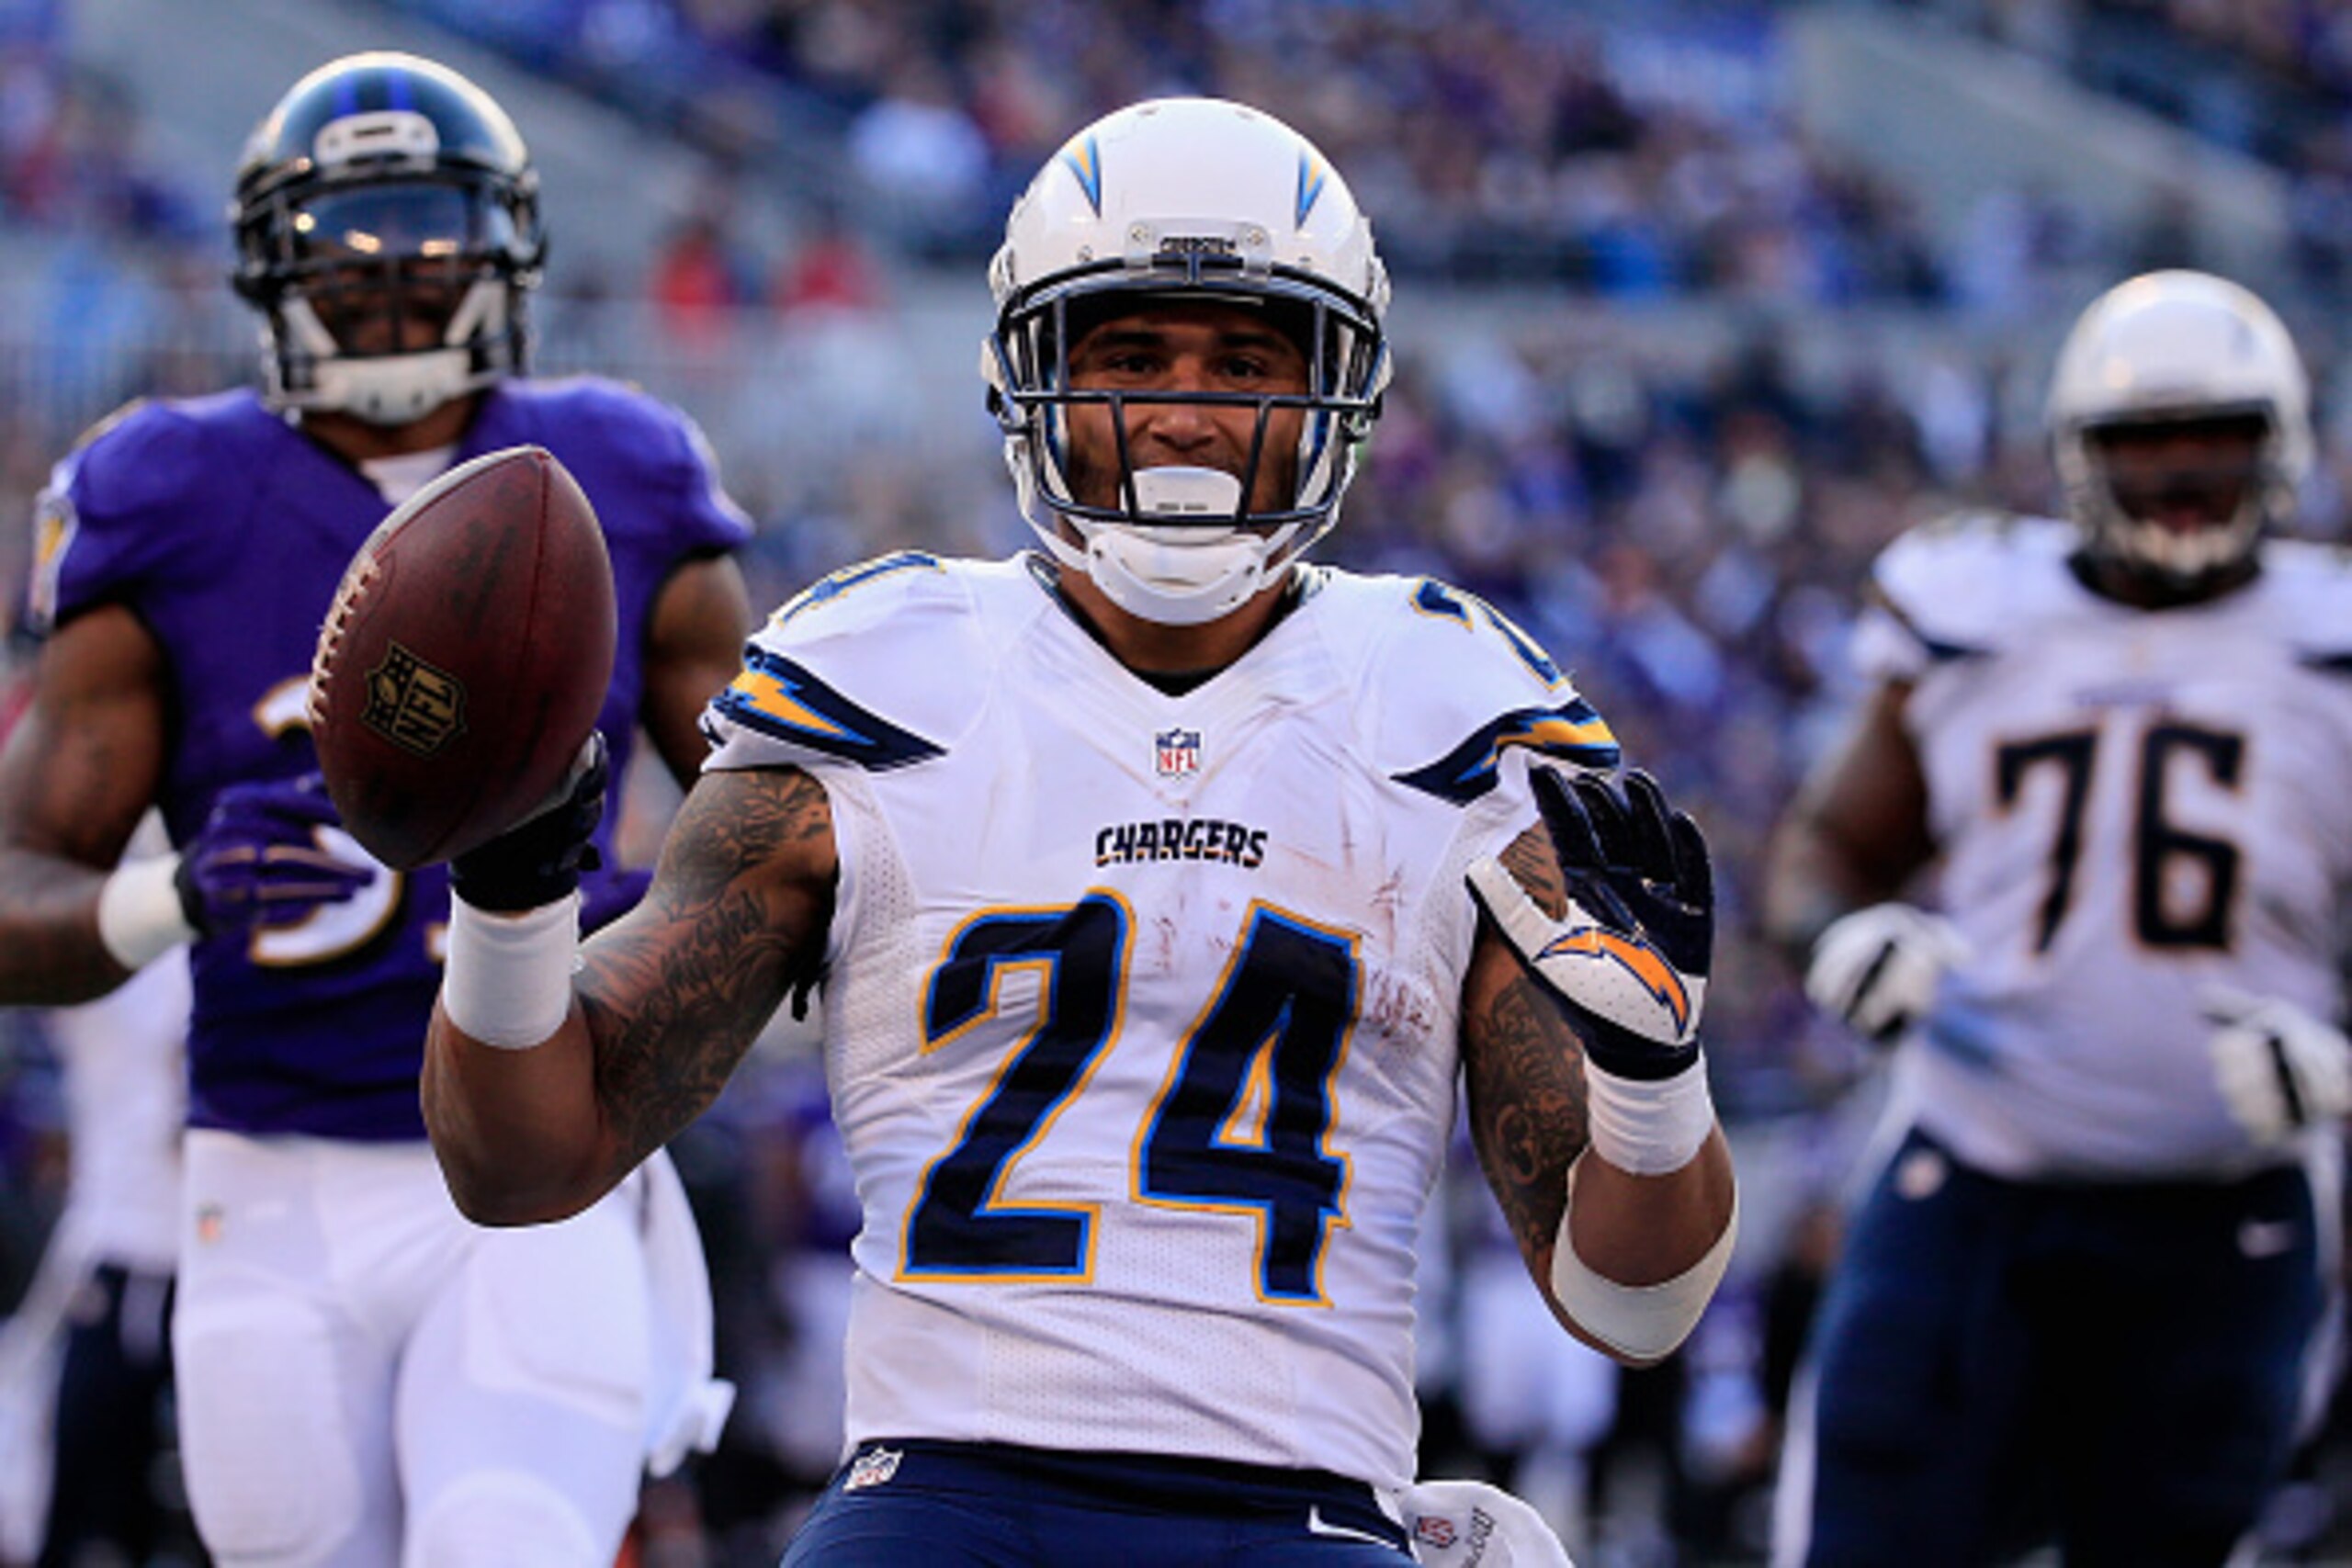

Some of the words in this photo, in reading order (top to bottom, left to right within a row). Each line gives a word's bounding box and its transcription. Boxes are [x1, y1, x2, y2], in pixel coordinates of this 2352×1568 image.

[391, 667, 458, 752] NFL
[1159, 747, 1196, 773] NFL
[1094, 818, 1268, 869] CHARGERS
[1984, 720, 2247, 961] 76
[894, 886, 1366, 1308] 24
